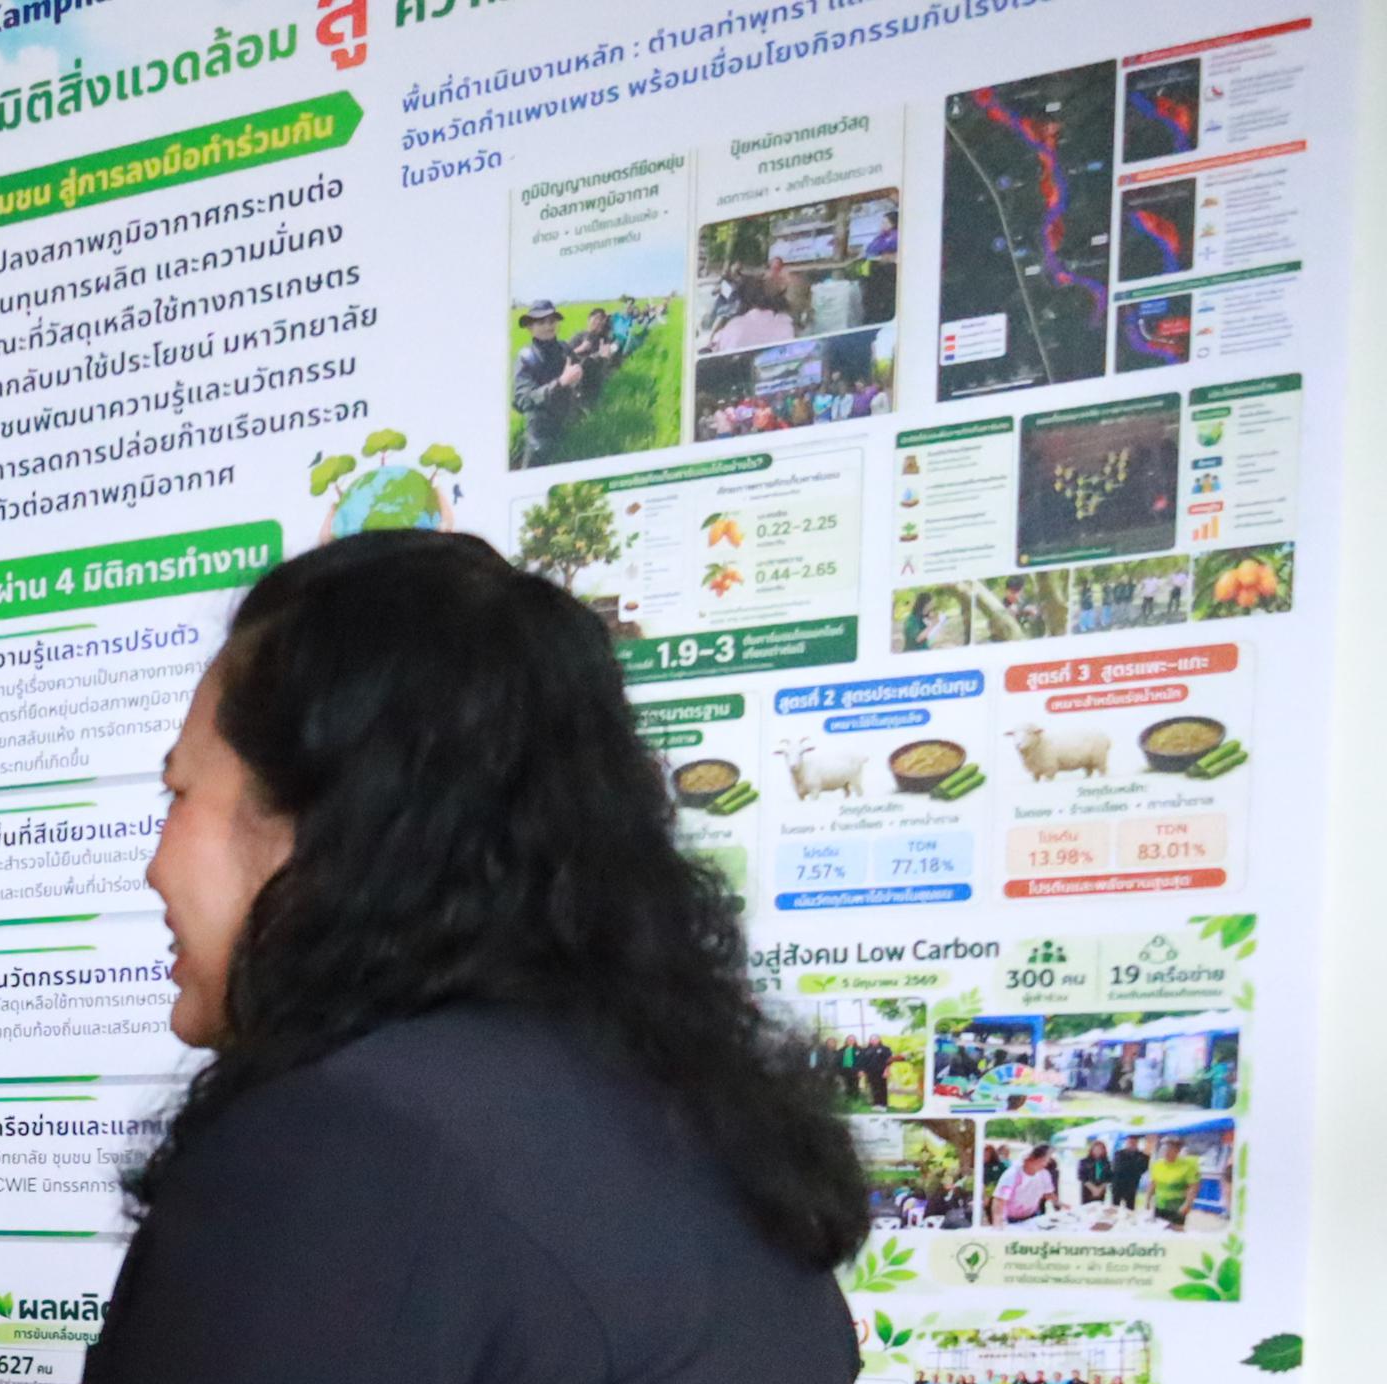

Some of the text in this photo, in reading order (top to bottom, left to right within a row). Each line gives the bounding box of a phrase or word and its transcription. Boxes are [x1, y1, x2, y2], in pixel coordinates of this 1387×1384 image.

[402, 85, 620, 151] จังหวัดกำแพงเพชร
[628, 0, 1053, 98] พร้อมเชื่อมโยงกิจกรรมกับโรง
[402, 42, 625, 113] พื้นที่ดำเนินงานหลัก
[58, 112, 334, 210] สู่การลงมือทำร่วมกัน
[401, 149, 502, 189] ในจังหวัด
[758, 147, 834, 175] การเกษตร
[155, 222, 344, 280] และความมั่นคง
[223, 305, 378, 356] มหาวิทยาลัย
[56, 568, 75, 597] 4
[82, 540, 270, 593] มิติการทำงาน
[656, 635, 735, 670] 1.9-3
[1079, 664, 1090, 682] 3
[824, 691, 836, 707] 2
[1138, 841, 1206, 861] 83.01%
[749, 936, 1000, 974] งสู่สังคม Low Carbon
[1005, 967, 1055, 989] 300
[1110, 964, 1140, 986] 19
[52, 1153, 92, 1169] ชุมชน
[13, 1326, 101, 1344] การขับเคลื่อนชุม
[37, 1364, 54, 1376] คน
